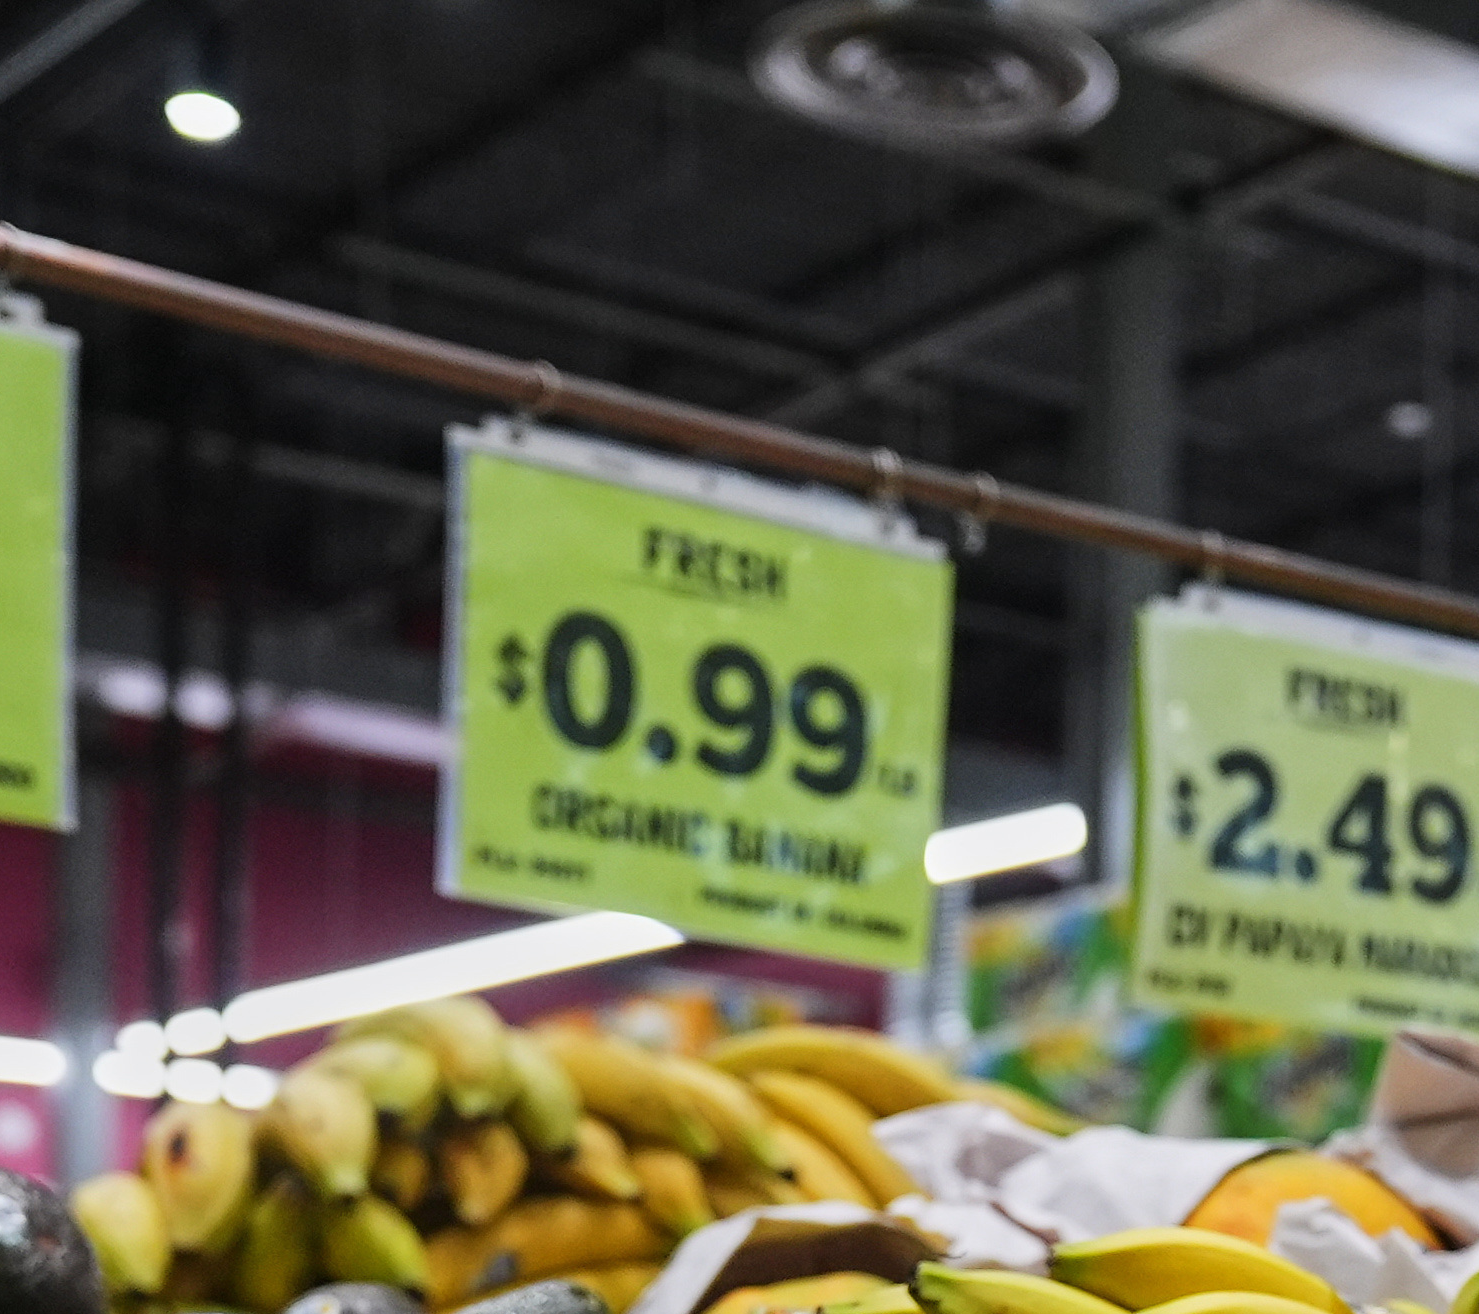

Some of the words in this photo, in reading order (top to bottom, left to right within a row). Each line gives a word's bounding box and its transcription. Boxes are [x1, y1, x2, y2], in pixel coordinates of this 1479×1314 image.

[642, 526, 789, 599] FRESH
[495, 609, 867, 801] $0.99
[532, 781, 708, 857] ORGANIC
[1174, 747, 1473, 906] $2.49
